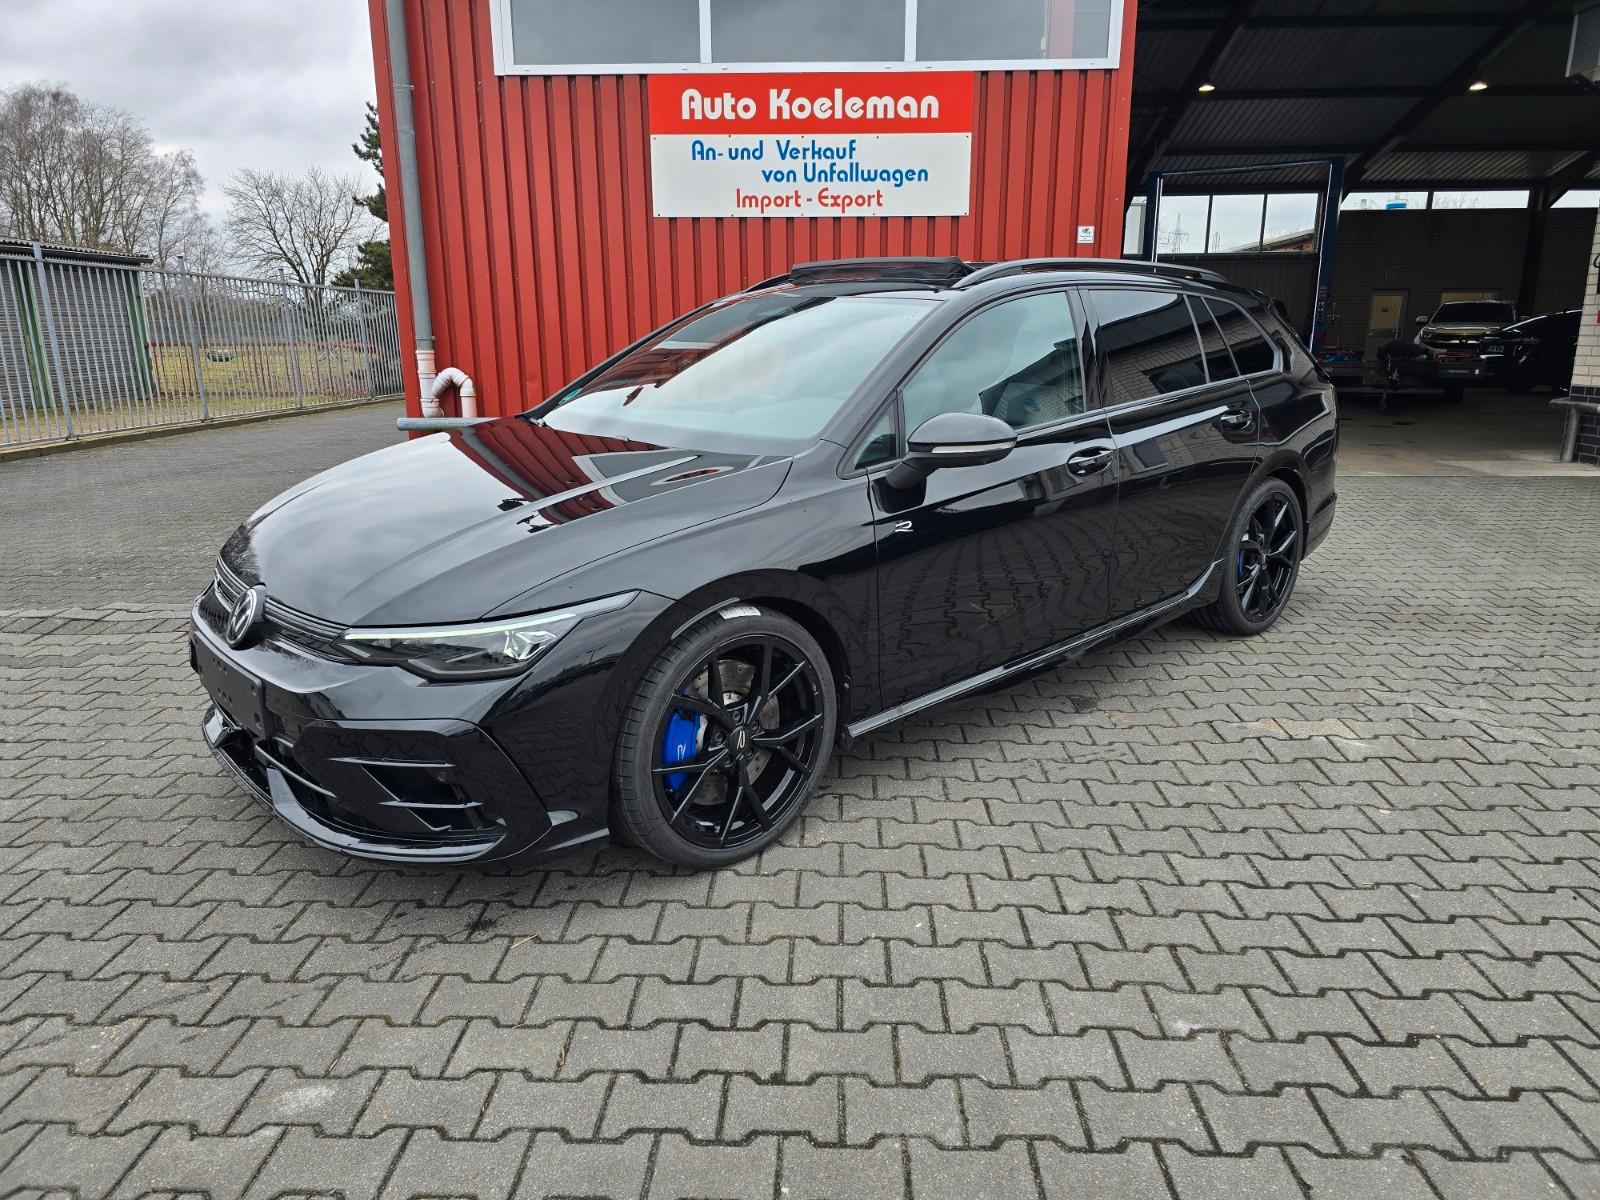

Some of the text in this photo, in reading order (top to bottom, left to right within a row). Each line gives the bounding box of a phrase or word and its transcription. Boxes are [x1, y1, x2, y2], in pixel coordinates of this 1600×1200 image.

[682, 88, 939, 120] Auto Koeleman
[691, 139, 857, 161] An- und Verkauf
[761, 162, 928, 188] von Unfallwagen
[736, 188, 802, 214] Import
[817, 187, 883, 214] Export
